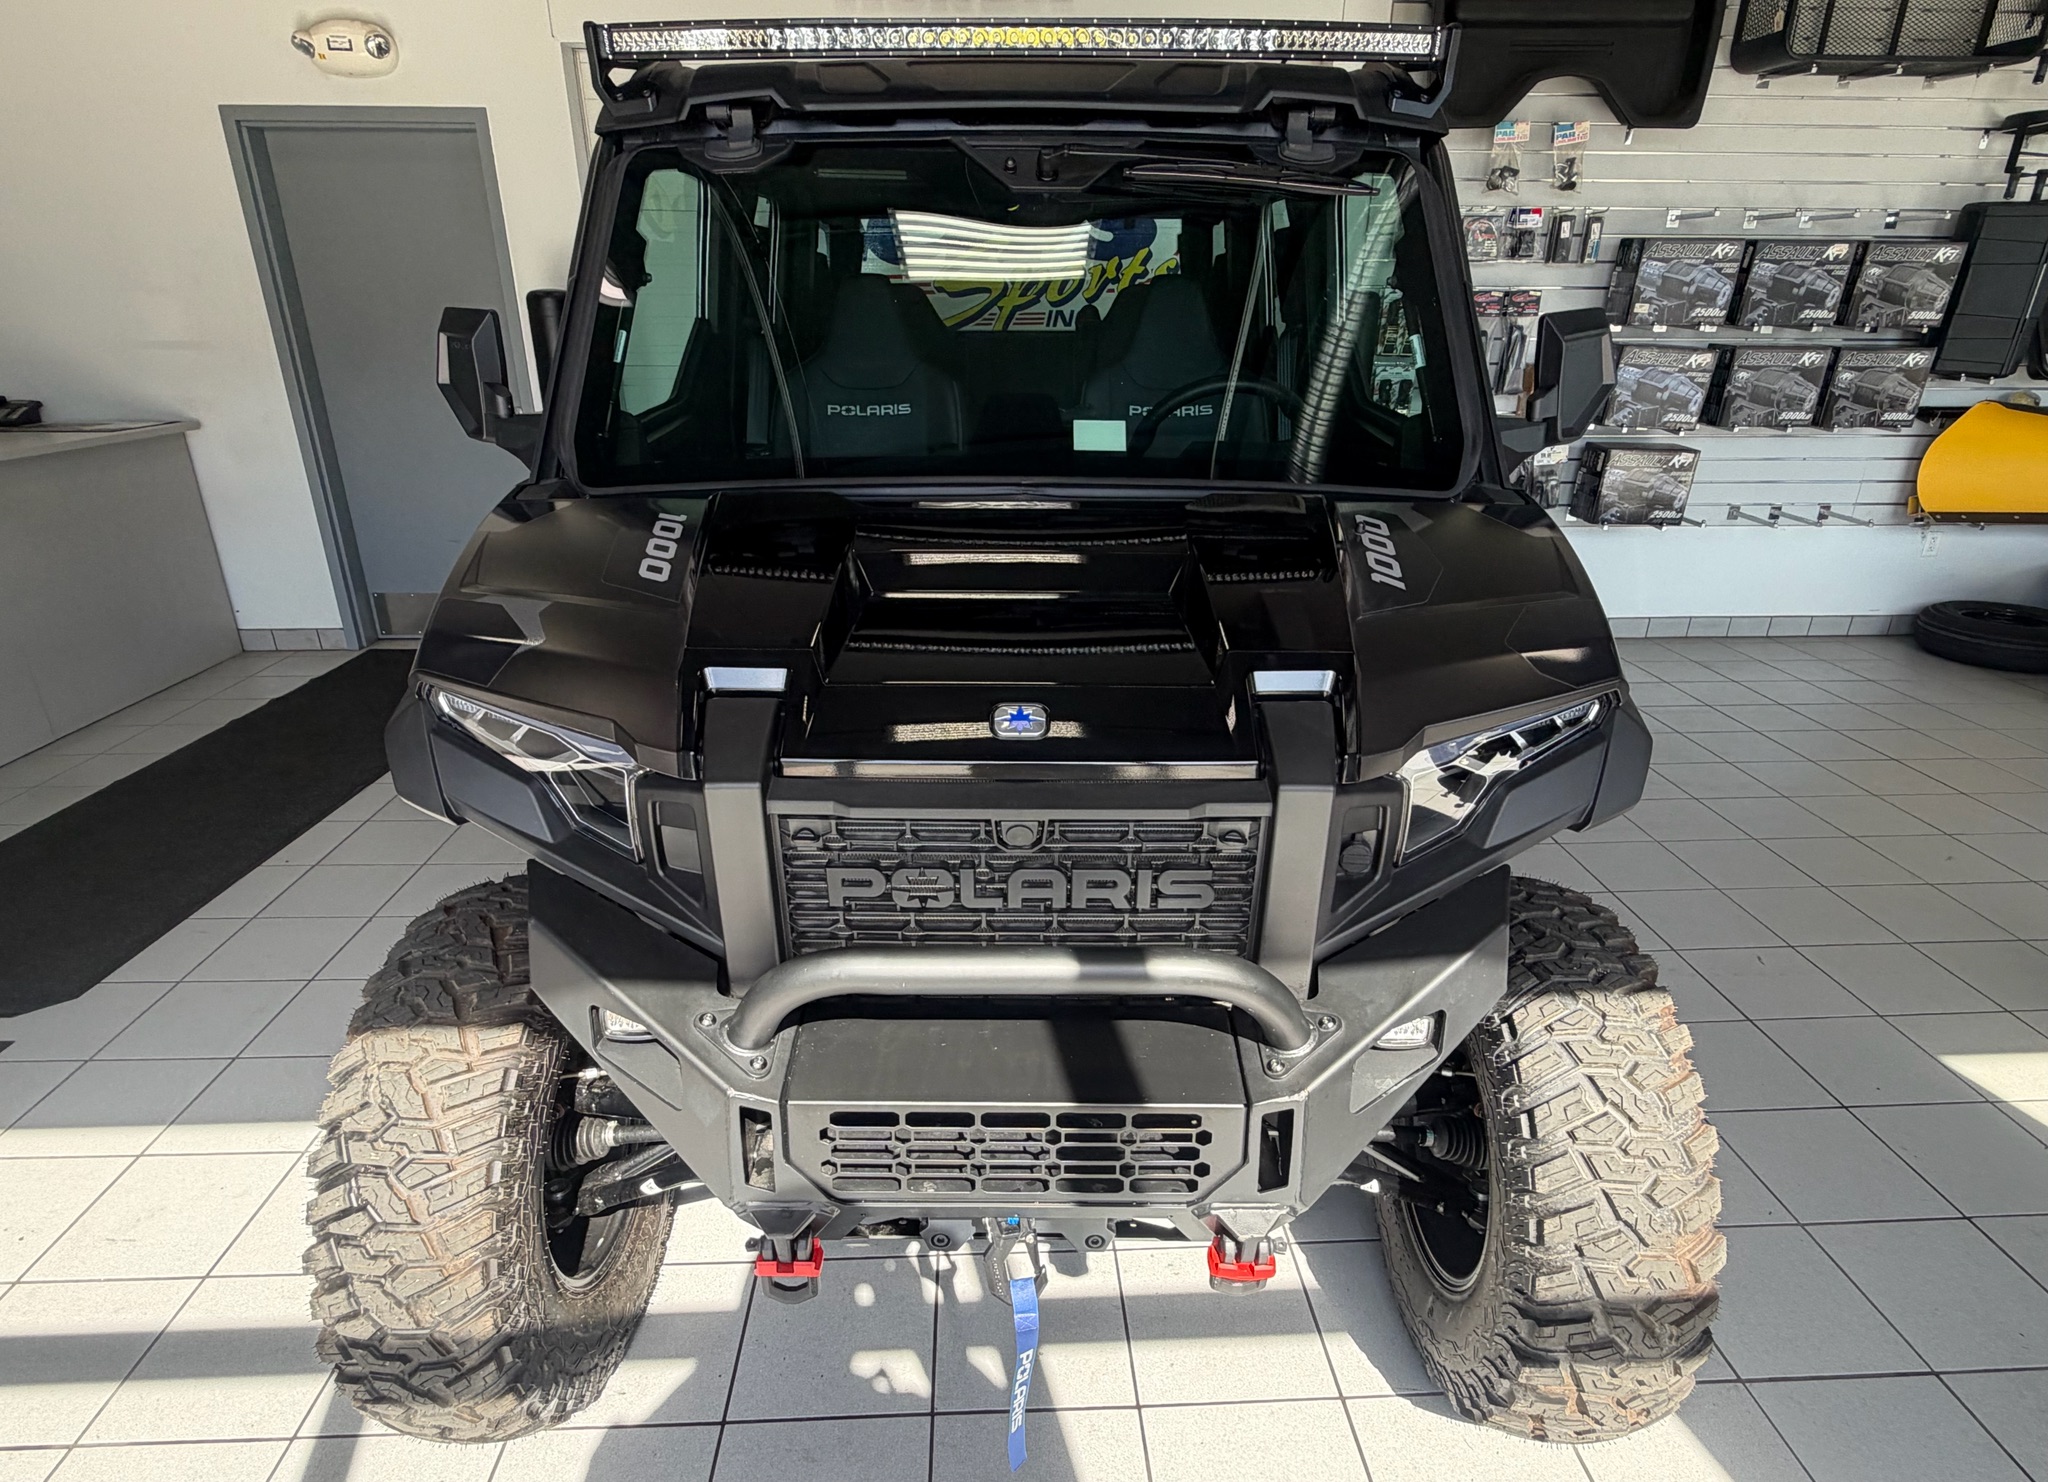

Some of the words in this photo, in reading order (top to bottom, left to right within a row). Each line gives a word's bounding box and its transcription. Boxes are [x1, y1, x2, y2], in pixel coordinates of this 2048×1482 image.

[1645, 242, 1718, 258] ASSAULT
[1757, 244, 1827, 259] ASSAULT
[1869, 245, 1938, 261] ASSAULT
[1623, 350, 1689, 366] ASSAULT
[1736, 351, 1804, 366] ASSAULT
[1841, 352, 1907, 367] ASSAULT
[827, 403, 911, 416] POLARIS
[1129, 404, 1213, 417] PARIS
[1608, 453, 1673, 467] ASSAULT
[638, 513, 687, 582] 1000
[1354, 514, 1407, 591] 1000
[826, 867, 1215, 909] POLARIS
[1011, 1349, 1034, 1433] POLARIS
